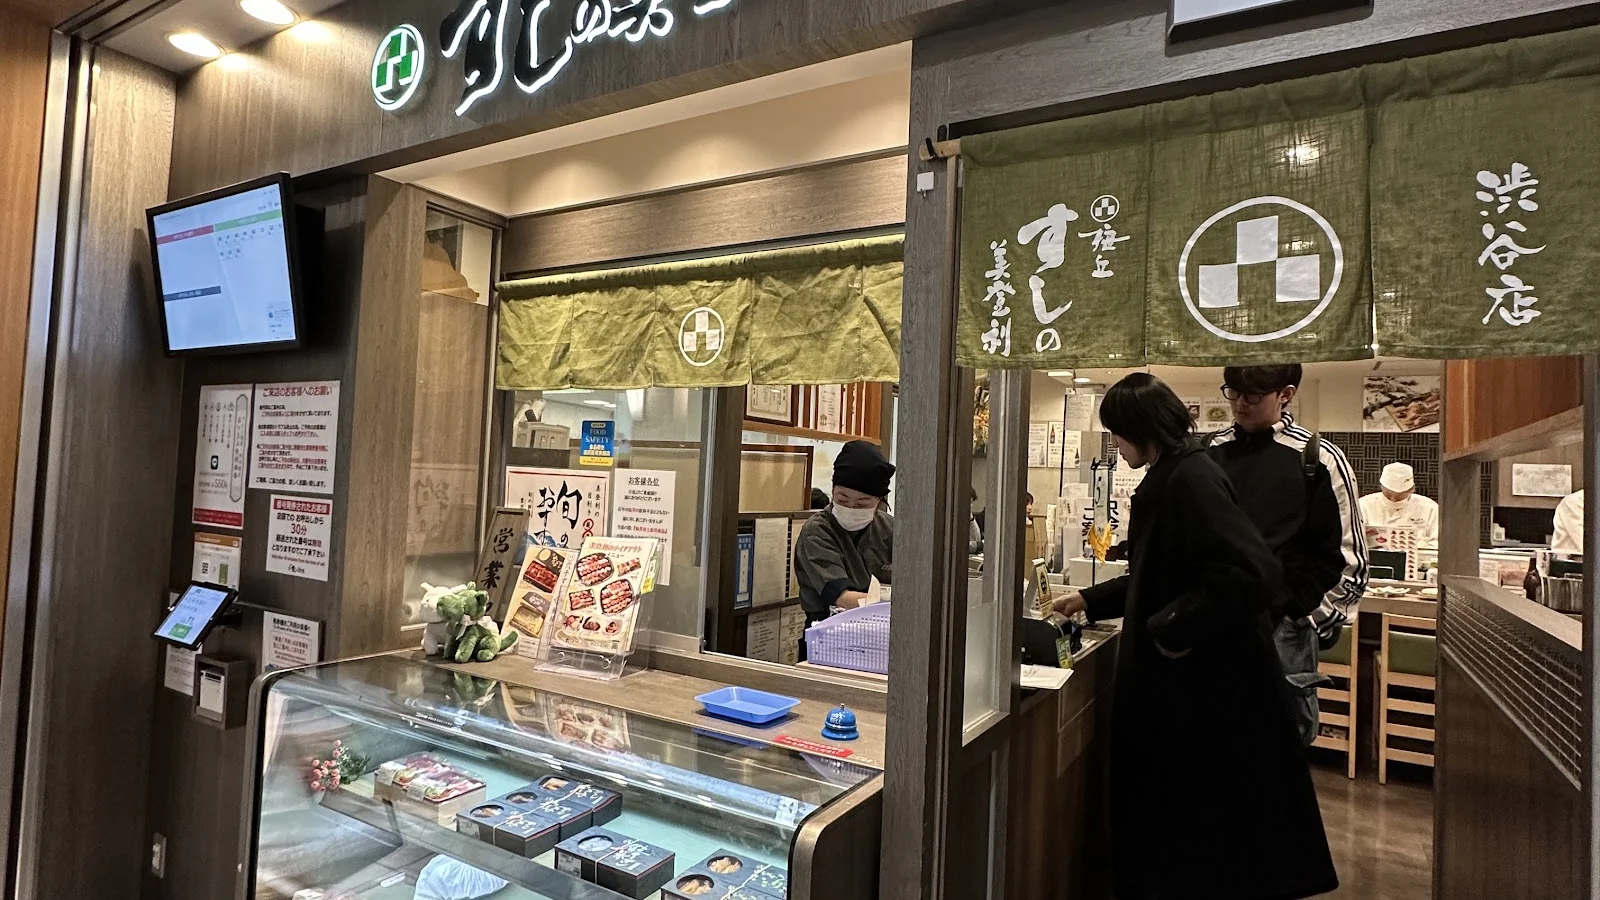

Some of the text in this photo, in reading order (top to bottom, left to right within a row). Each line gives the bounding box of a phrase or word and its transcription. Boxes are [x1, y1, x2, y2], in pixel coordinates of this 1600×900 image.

[1475, 162, 1546, 326] 渋谷店
[1017, 203, 1079, 352] すしの
[981, 239, 1016, 357] 美登利
[590, 428, 607, 436] FOOD
[585, 435, 610, 444] SAFETY
[628, 476, 660, 486] お客様各位
[291, 523, 307, 536] 30分
